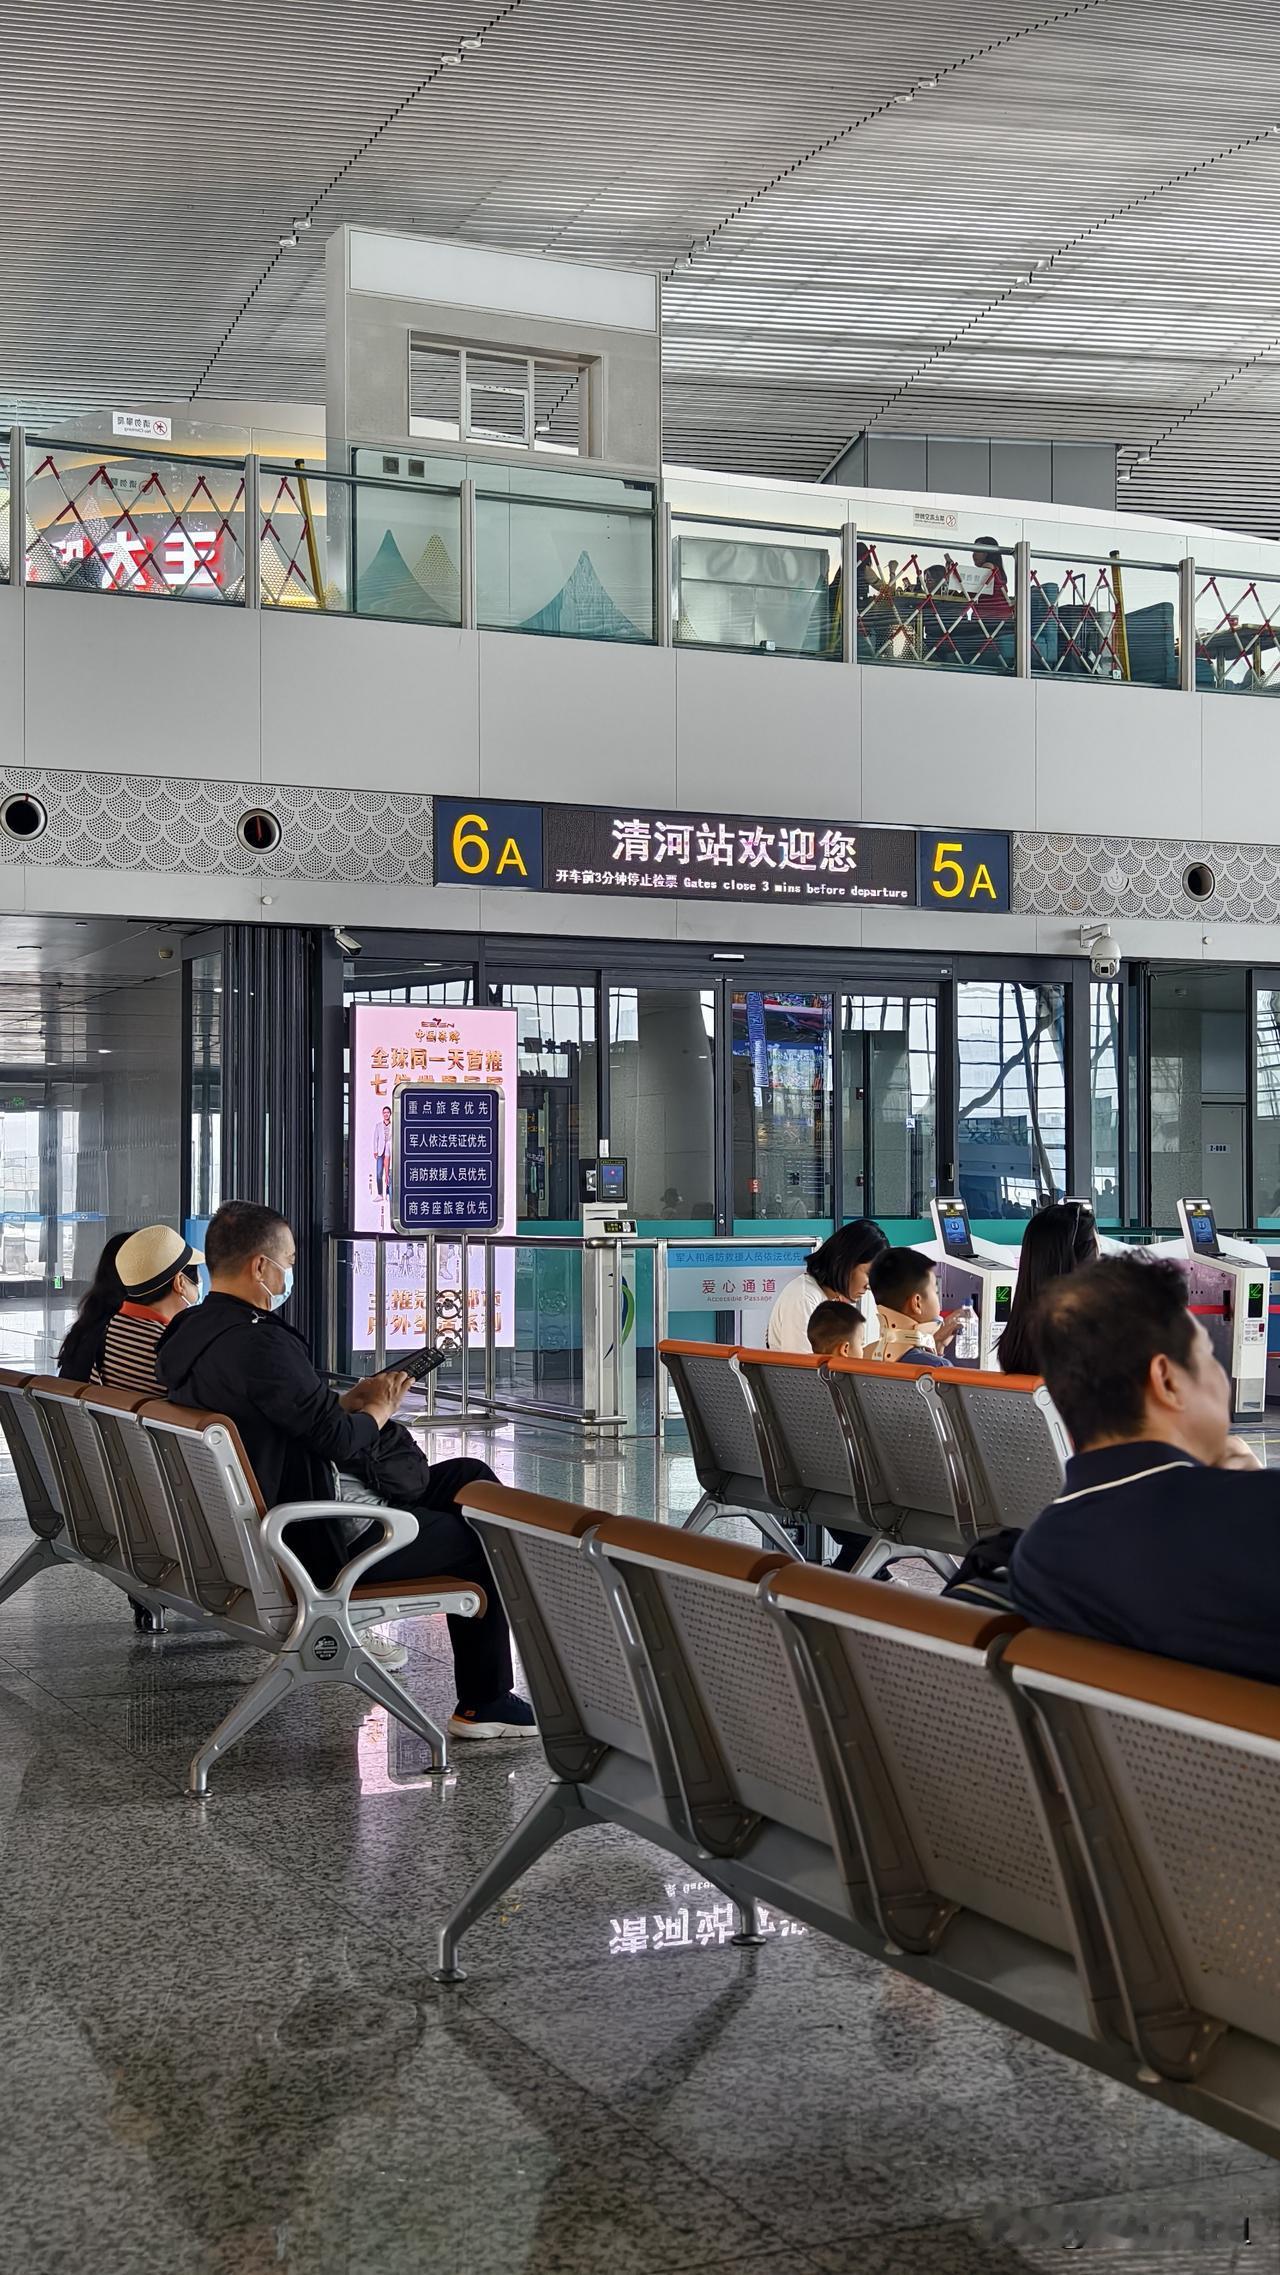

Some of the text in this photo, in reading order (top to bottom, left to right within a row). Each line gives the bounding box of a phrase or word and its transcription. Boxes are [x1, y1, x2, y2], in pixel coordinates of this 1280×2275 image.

[453, 813, 528, 876] 6A
[611, 819, 857, 872] 清河站欢迎您
[555, 869, 678, 888] 开车前3分钟停止检票
[932, 842, 997, 899] 5A
[683, 879, 908, 899] Gates close 3 mins before departure
[371, 1047, 503, 1072] 全球同一天首推
[408, 1100, 489, 1115] 重点旅客优先
[409, 1133, 487, 1148] 军人依法凭证优先
[409, 1167, 487, 1182] 消防救援人员优先
[408, 1200, 489, 1216] 商务座旅客优先
[702, 1279, 776, 1294] 爱心通道
